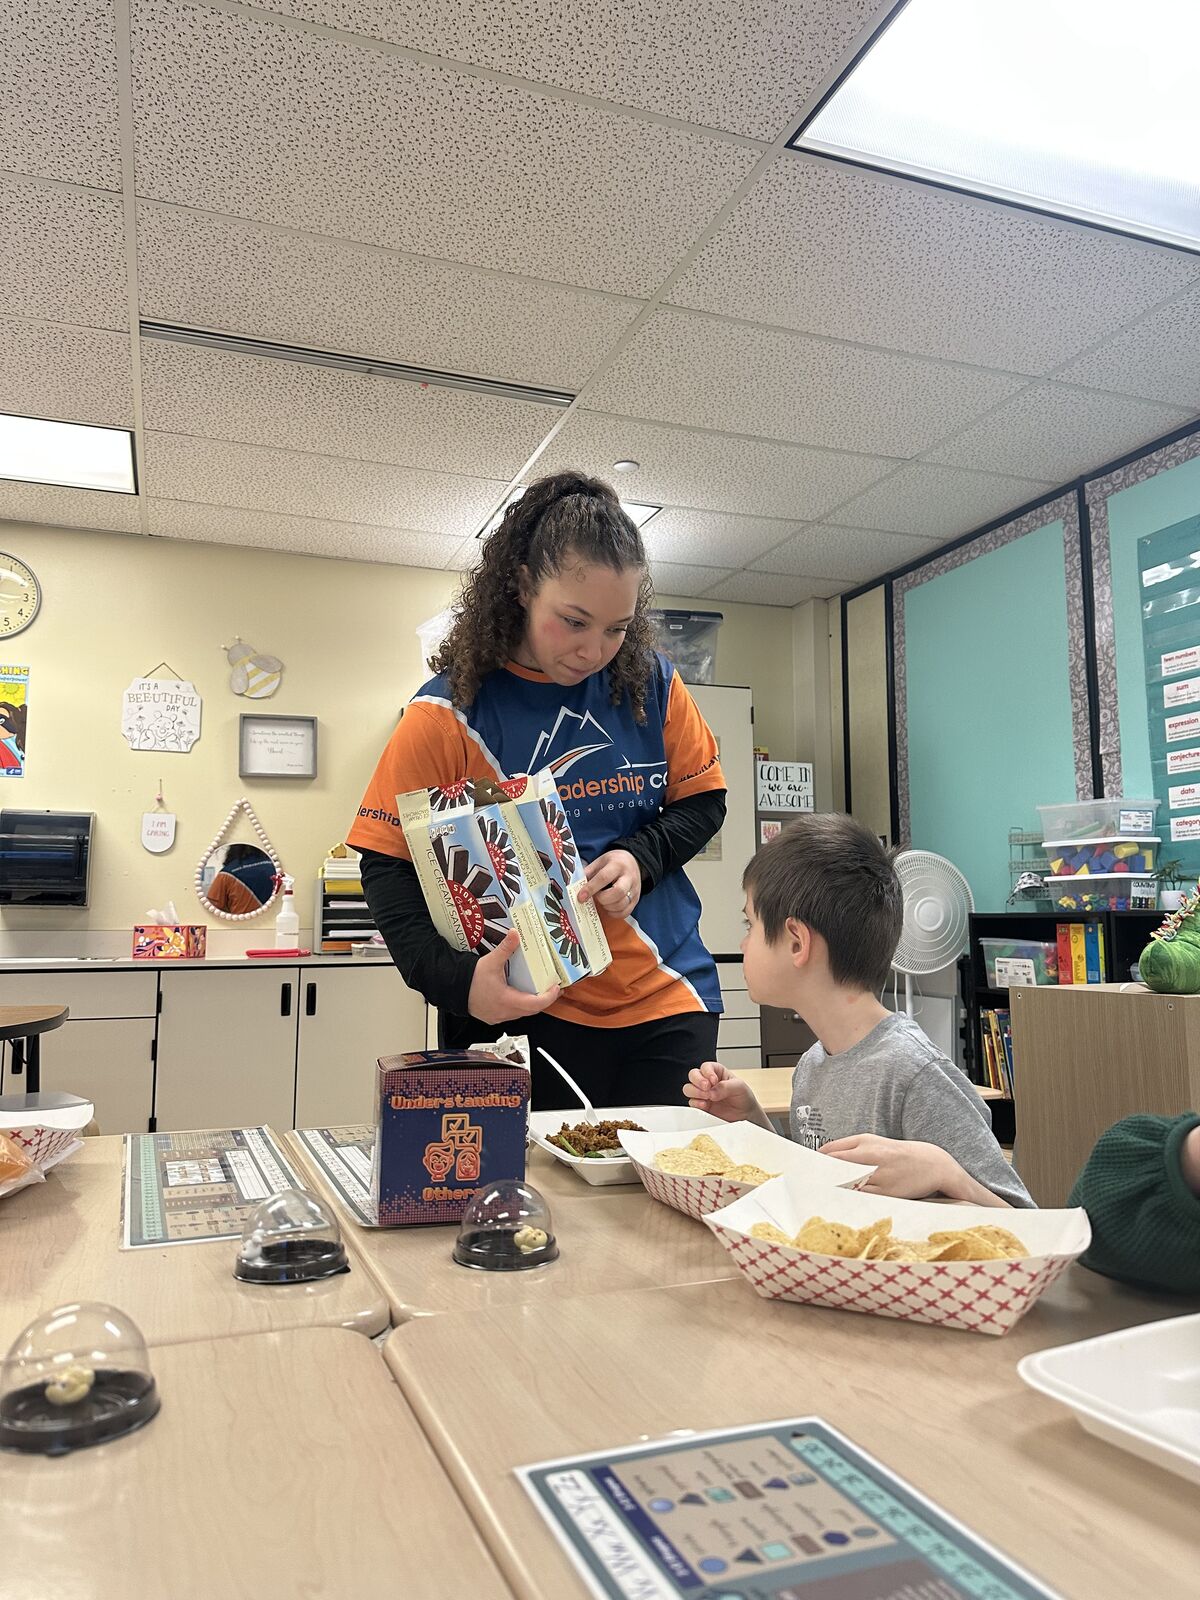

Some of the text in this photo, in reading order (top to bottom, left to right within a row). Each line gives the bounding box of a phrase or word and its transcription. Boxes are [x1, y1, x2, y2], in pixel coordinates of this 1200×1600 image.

[23, 593, 29, 602] 3
[18, 608, 24, 616] 4
[3, 617, 10, 626] 5
[1175, 650, 1196, 661] numbers
[138, 682, 151, 690] IT'S
[1176, 684, 1189, 692] sum
[166, 704, 180, 712] DAY
[1168, 717, 1198, 730] expression
[760, 764, 811, 782] COME IN
[768, 784, 803, 792] we are
[600, 799, 654, 812] leaders
[759, 794, 814, 808] AWESOME
[357, 804, 400, 826] ership
[426, 848, 438, 866] ICE
[434, 868, 454, 908] CREAM
[453, 884, 484, 943] STONE RIDGE
[514, 919, 528, 952] SANDWICHES
[391, 1094, 522, 1110] Understanding
